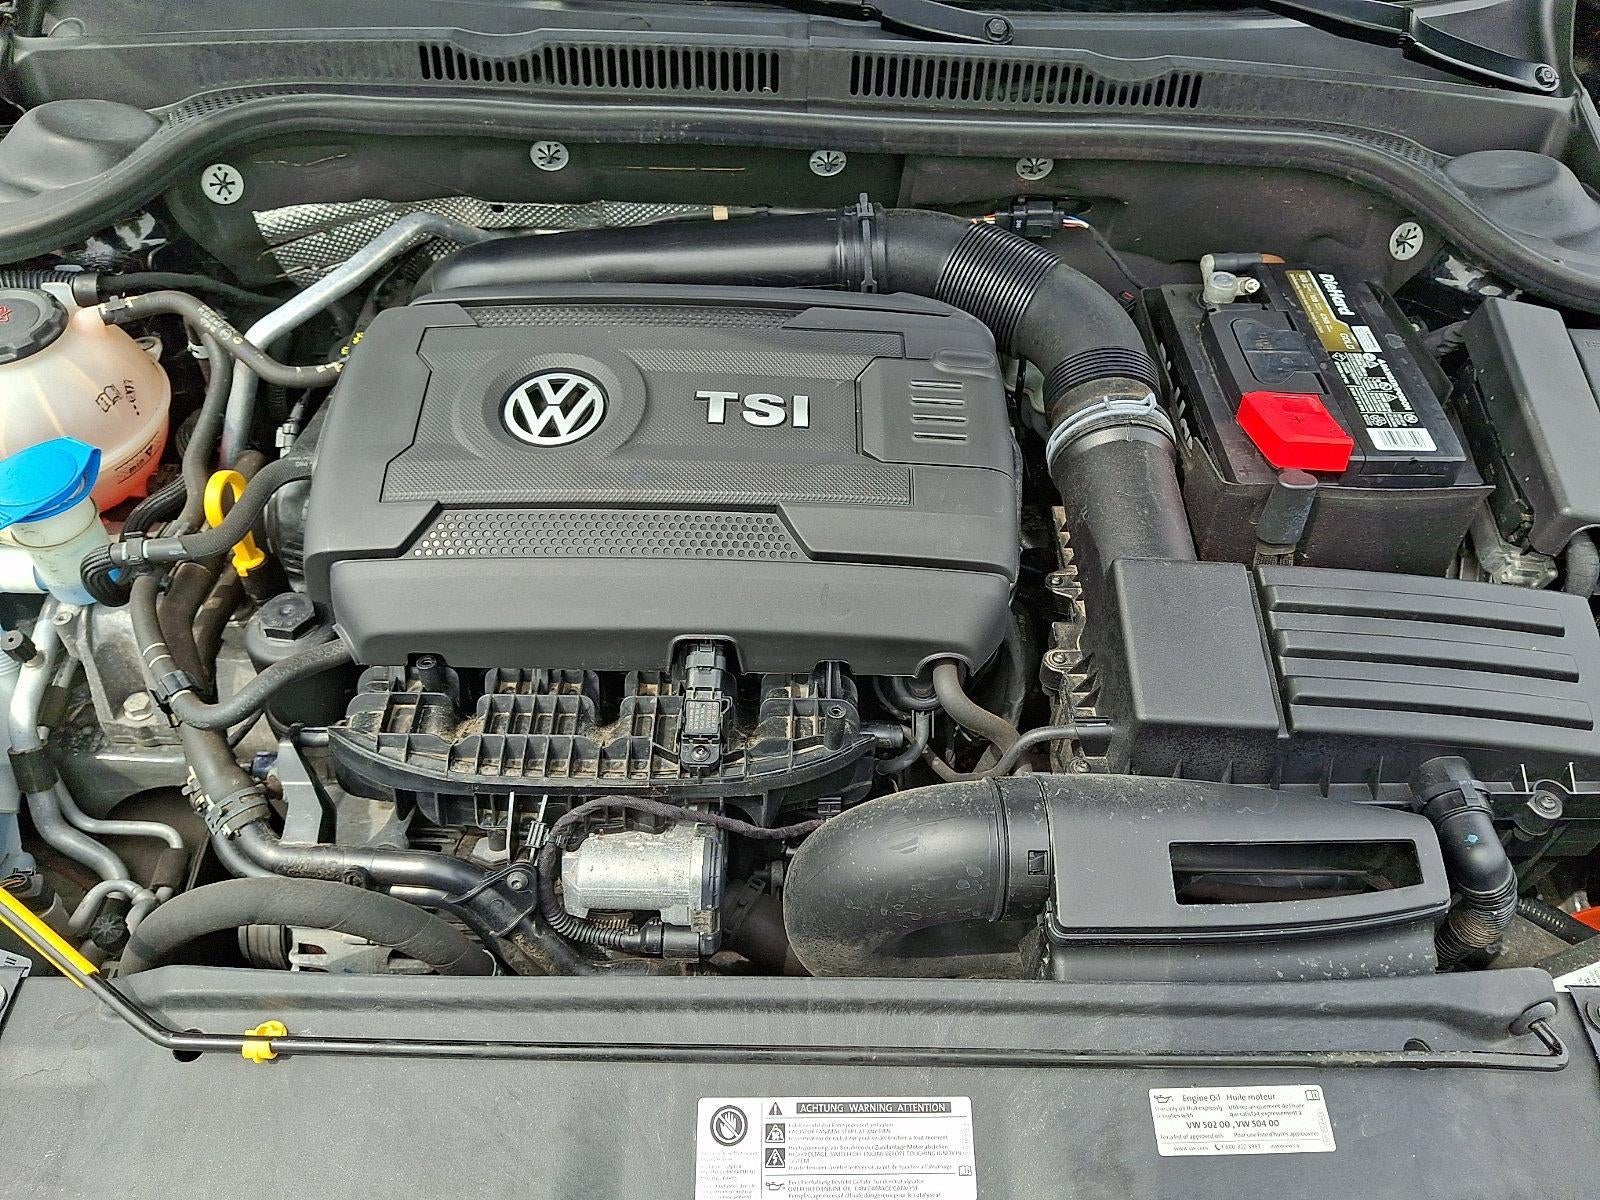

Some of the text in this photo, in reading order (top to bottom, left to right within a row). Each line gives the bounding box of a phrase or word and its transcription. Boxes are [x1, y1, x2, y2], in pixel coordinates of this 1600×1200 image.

[1318, 274, 1356, 316] DieHard
[1340, 332, 1355, 350] GOLD
[504, 373, 604, 445] VW
[696, 391, 808, 426] TSI
[800, 1103, 946, 1112] ACHTUNG WARNING ATTENTION
[1182, 1094, 1208, 1104] Engine
